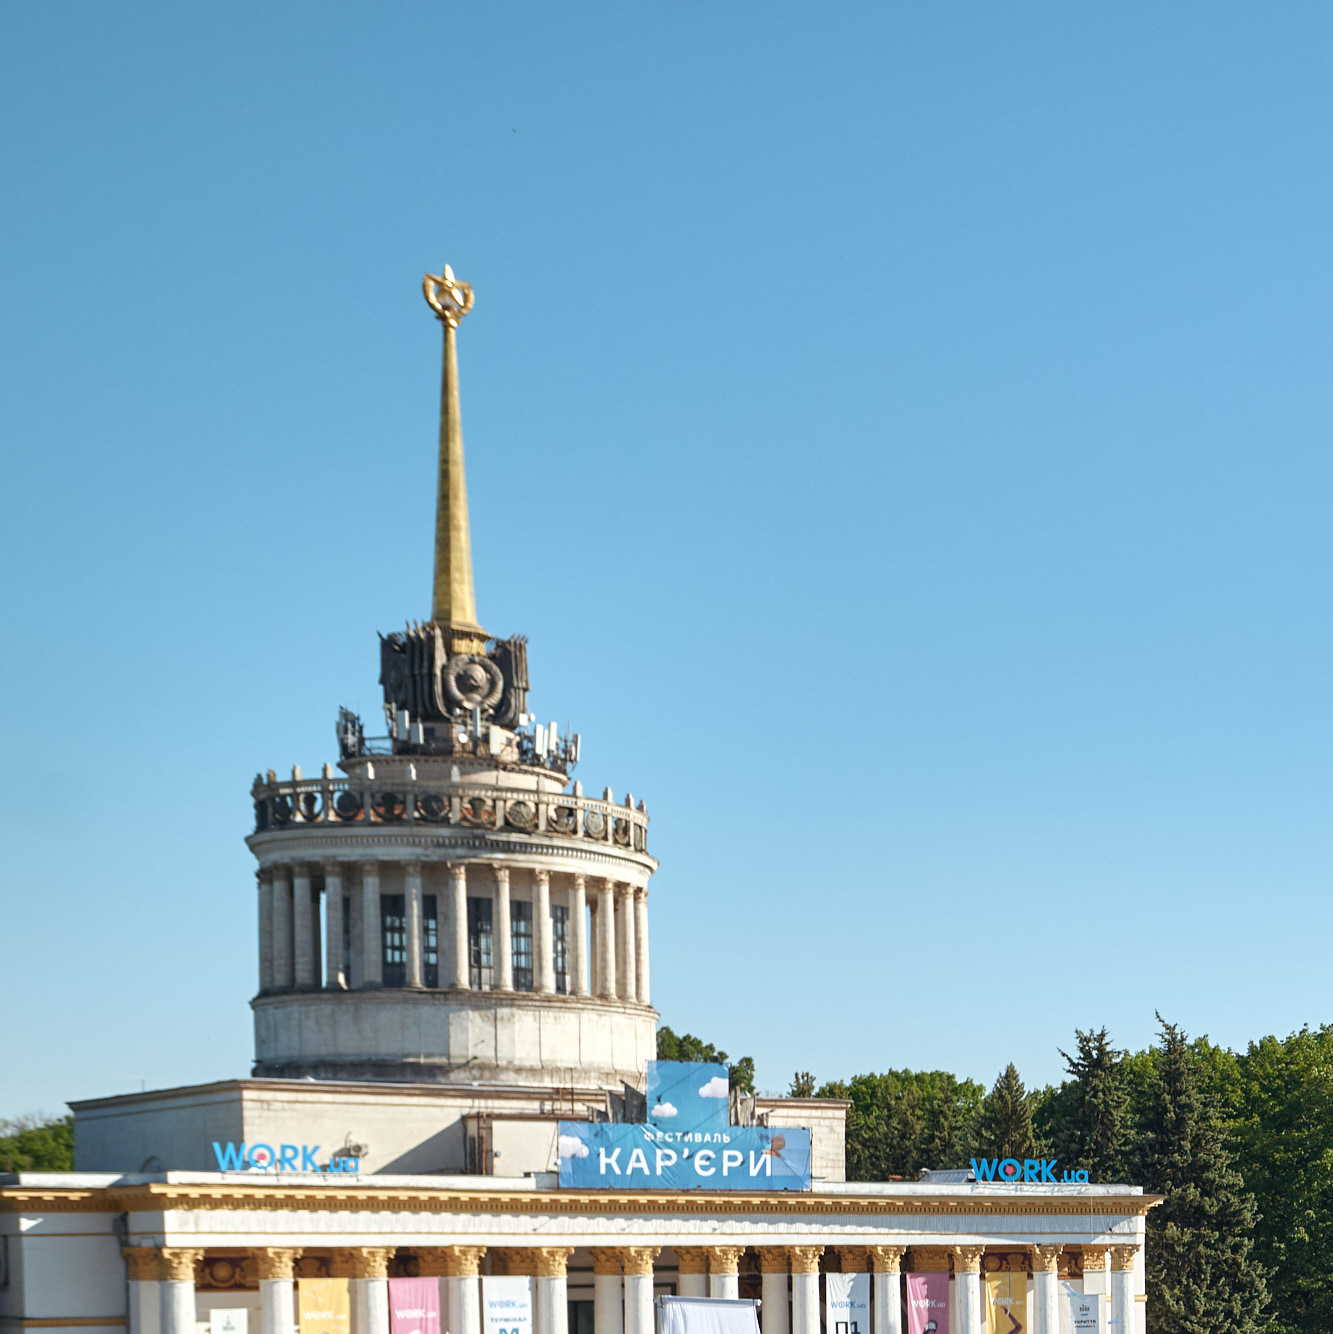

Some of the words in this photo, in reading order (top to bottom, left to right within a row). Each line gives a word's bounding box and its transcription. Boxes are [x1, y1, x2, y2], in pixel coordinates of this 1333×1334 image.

[644, 1131, 731, 1143] ФЕСТИВАЛЬ
[212, 1141, 360, 1173] WORK.ua
[600, 1147, 772, 1177] КАР'ЄРИ
[970, 1158, 1089, 1183] WORK.ua
[831, 1300, 866, 1309] WORK.ua
[835, 1321, 861, 1334] П1
